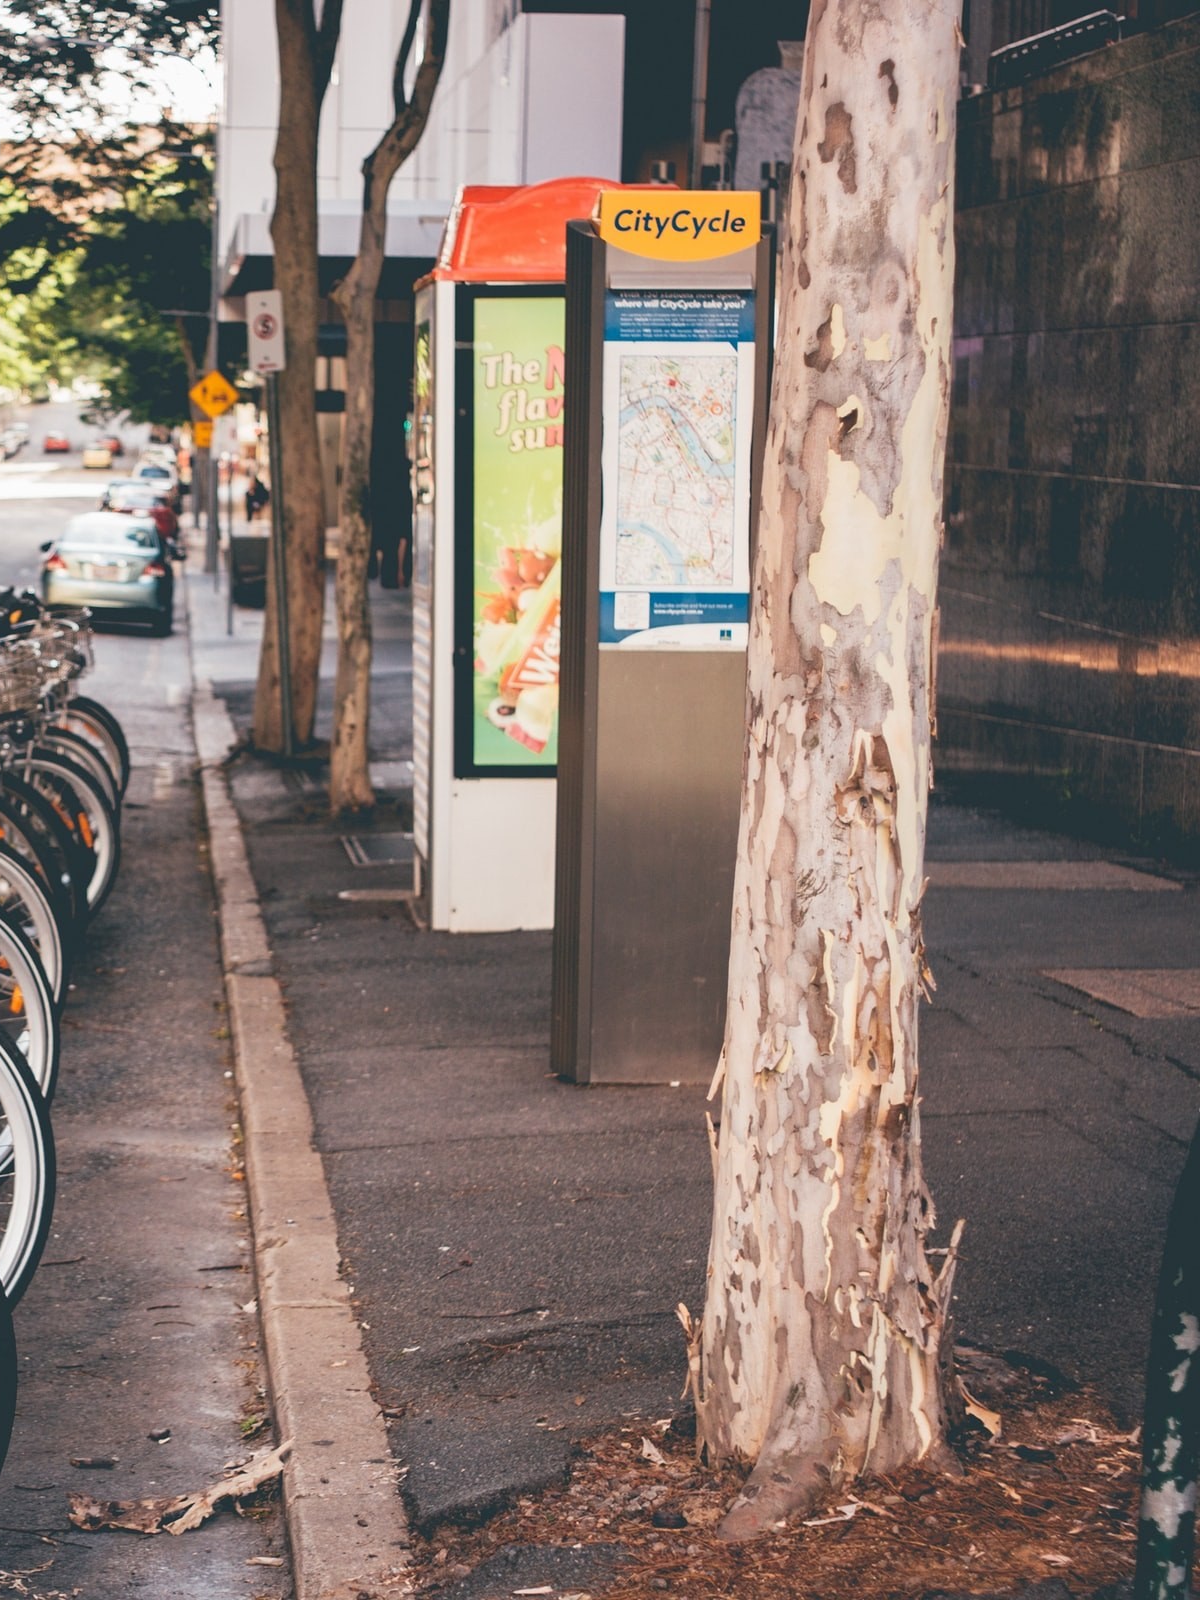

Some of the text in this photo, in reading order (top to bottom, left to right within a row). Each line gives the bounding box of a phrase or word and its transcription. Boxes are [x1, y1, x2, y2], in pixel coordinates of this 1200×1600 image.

[614, 209, 746, 239] CityCycle
[614, 299, 746, 311] where will CityCycle take you?
[480, 350, 540, 390] The
